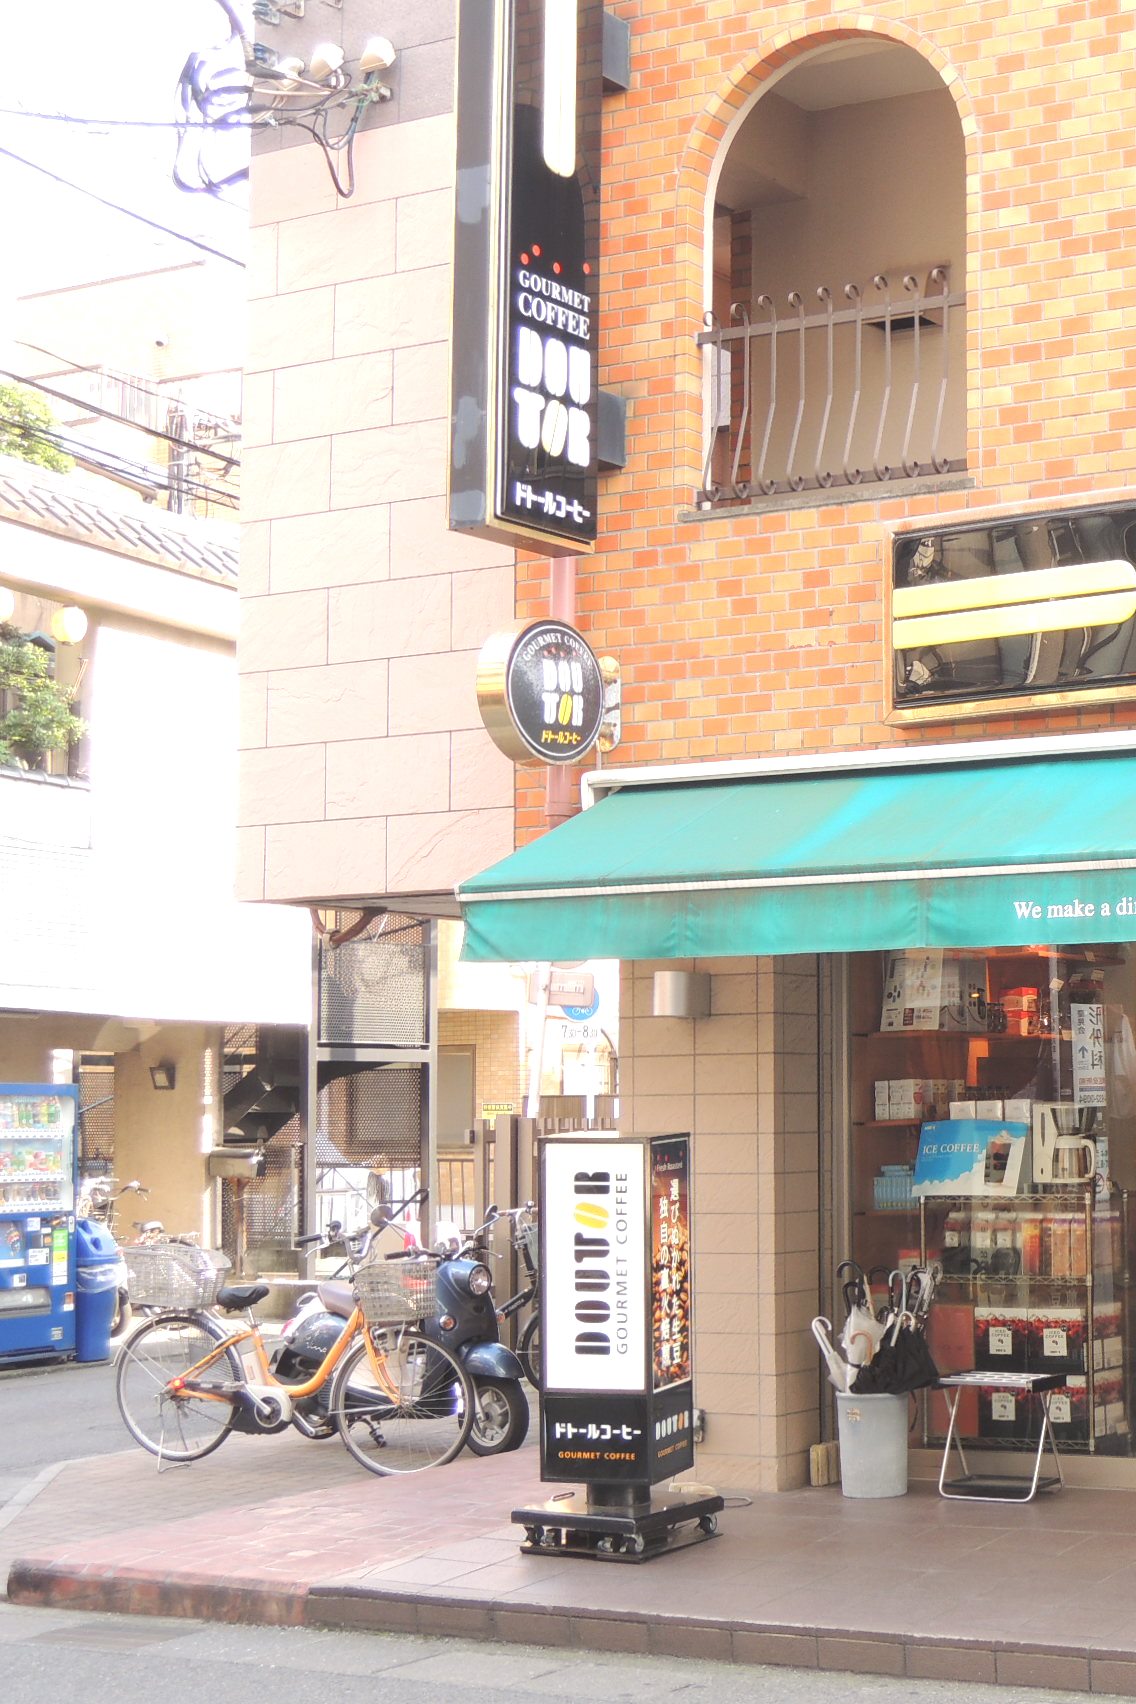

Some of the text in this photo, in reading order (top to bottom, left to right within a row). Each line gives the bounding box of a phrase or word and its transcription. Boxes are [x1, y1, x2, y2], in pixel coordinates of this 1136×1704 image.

[518, 270, 591, 313] GOURMET
[518, 292, 591, 340] COFFEE
[515, 481, 591, 524] ドトールコーヒー
[522, 632, 562, 661] GOURMET
[541, 729, 581, 744] ドトールコーヒー
[1013, 901, 1042, 920] We
[1046, 899, 1095, 918] make
[1100, 903, 1111, 917] a
[923, 1143, 980, 1154] ICE COFFEE
[574, 1171, 611, 1355] DOUTOR
[616, 1173, 629, 1355] GOURMET COFFEE
[670, 1178, 682, 1365] 選びぬかれた生豆
[555, 1422, 642, 1440] ドトールコーヒー
[655, 1410, 689, 1440] DOUTOR
[558, 1451, 636, 1461] GOURMET COFFEE
